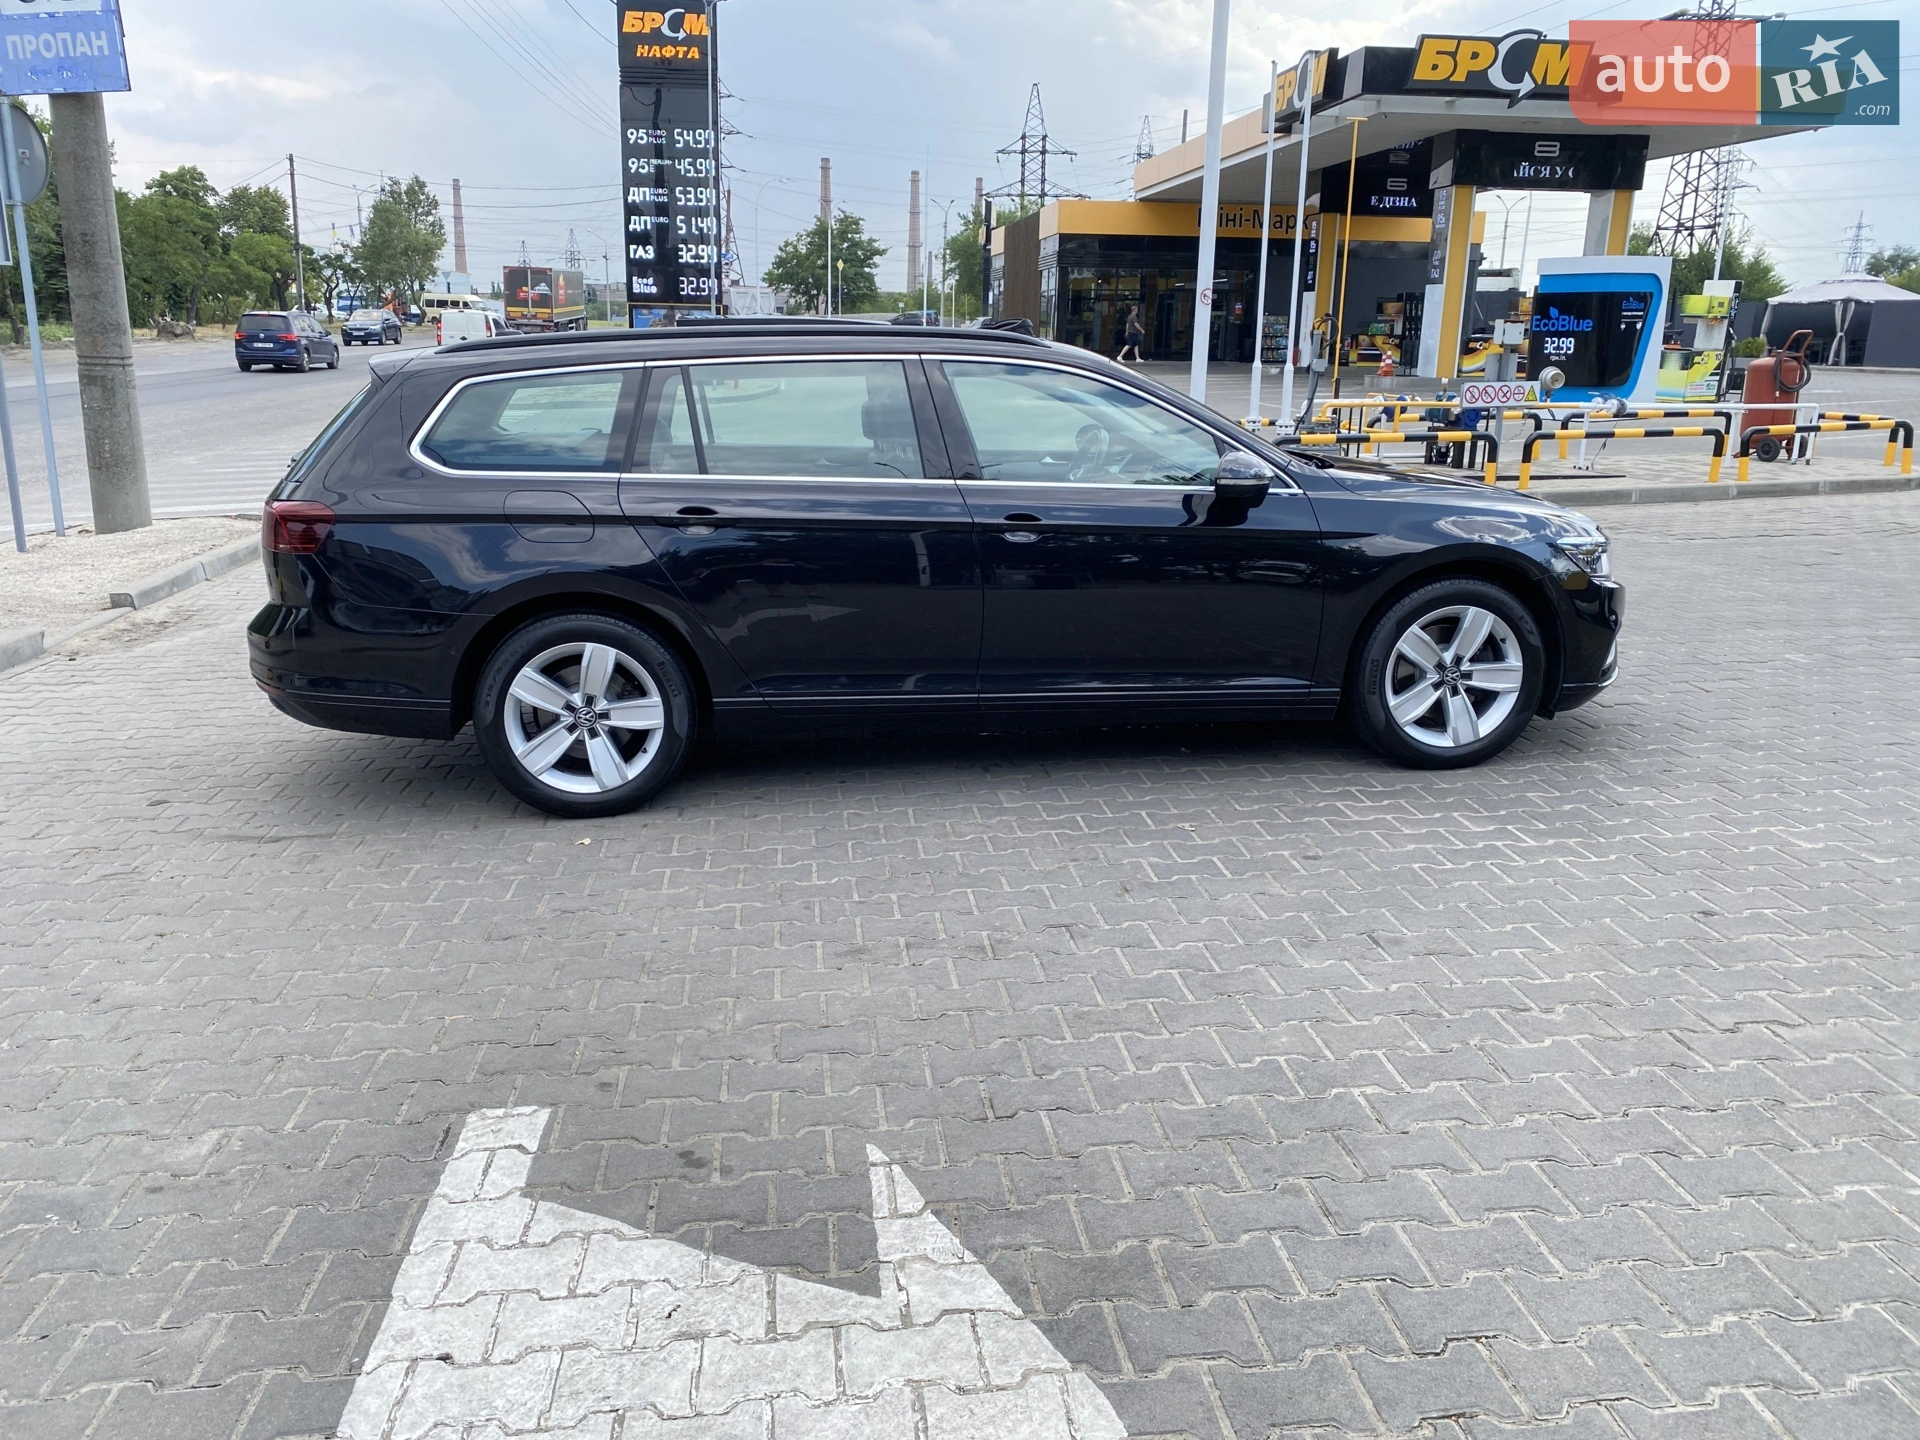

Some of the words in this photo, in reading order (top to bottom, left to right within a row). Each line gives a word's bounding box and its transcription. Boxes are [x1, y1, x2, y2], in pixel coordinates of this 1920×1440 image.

[622, 8, 708, 41] БРСМ
[5, 30, 109, 60] ПРОПАН
[636, 44, 699, 58] НАФТА
[1413, 33, 1591, 98] БРСМ
[627, 128, 648, 144] 95
[674, 128, 715, 148] 54.99
[1534, 141, 1560, 156] 8
[628, 158, 649, 173] 95
[675, 158, 716, 177] 45.99
[1386, 178, 1407, 190] 6
[628, 186, 650, 203] ДП
[675, 187, 717, 206] 53.99
[629, 215, 652, 231] ДП
[629, 244, 654, 259] ГАЗ
[678, 243, 718, 264] 32.99
[632, 284, 658, 293] Blue
[679, 277, 719, 295] 32.99
[1532, 315, 1593, 332] EcoBlue
[1543, 337, 1575, 354] 32.99
